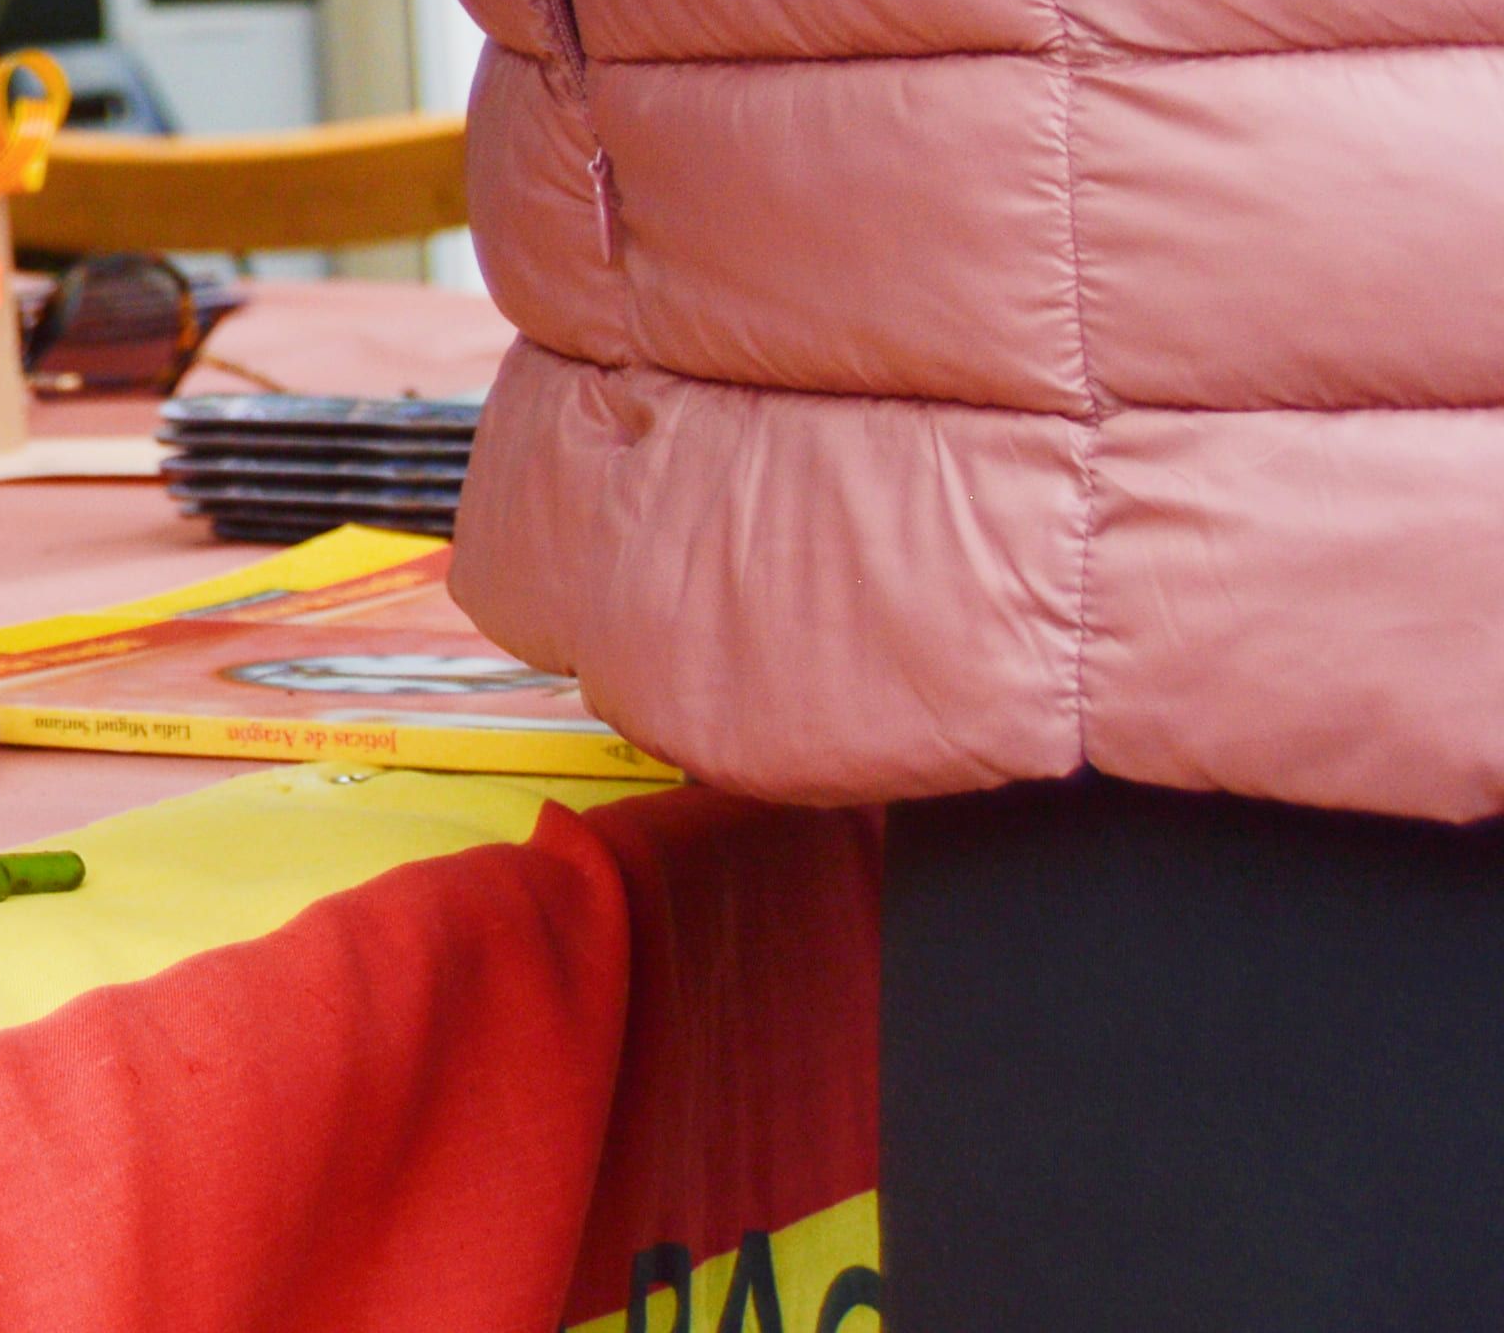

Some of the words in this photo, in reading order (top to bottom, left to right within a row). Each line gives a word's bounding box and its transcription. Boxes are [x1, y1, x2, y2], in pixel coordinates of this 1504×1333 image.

[34, 715, 89, 734] Soriano
[96, 718, 149, 738] Miguel
[152, 723, 191, 741] Lidia
[227, 722, 293, 748] Aragón
[303, 728, 327, 751] de
[336, 726, 396, 753] Joticas
